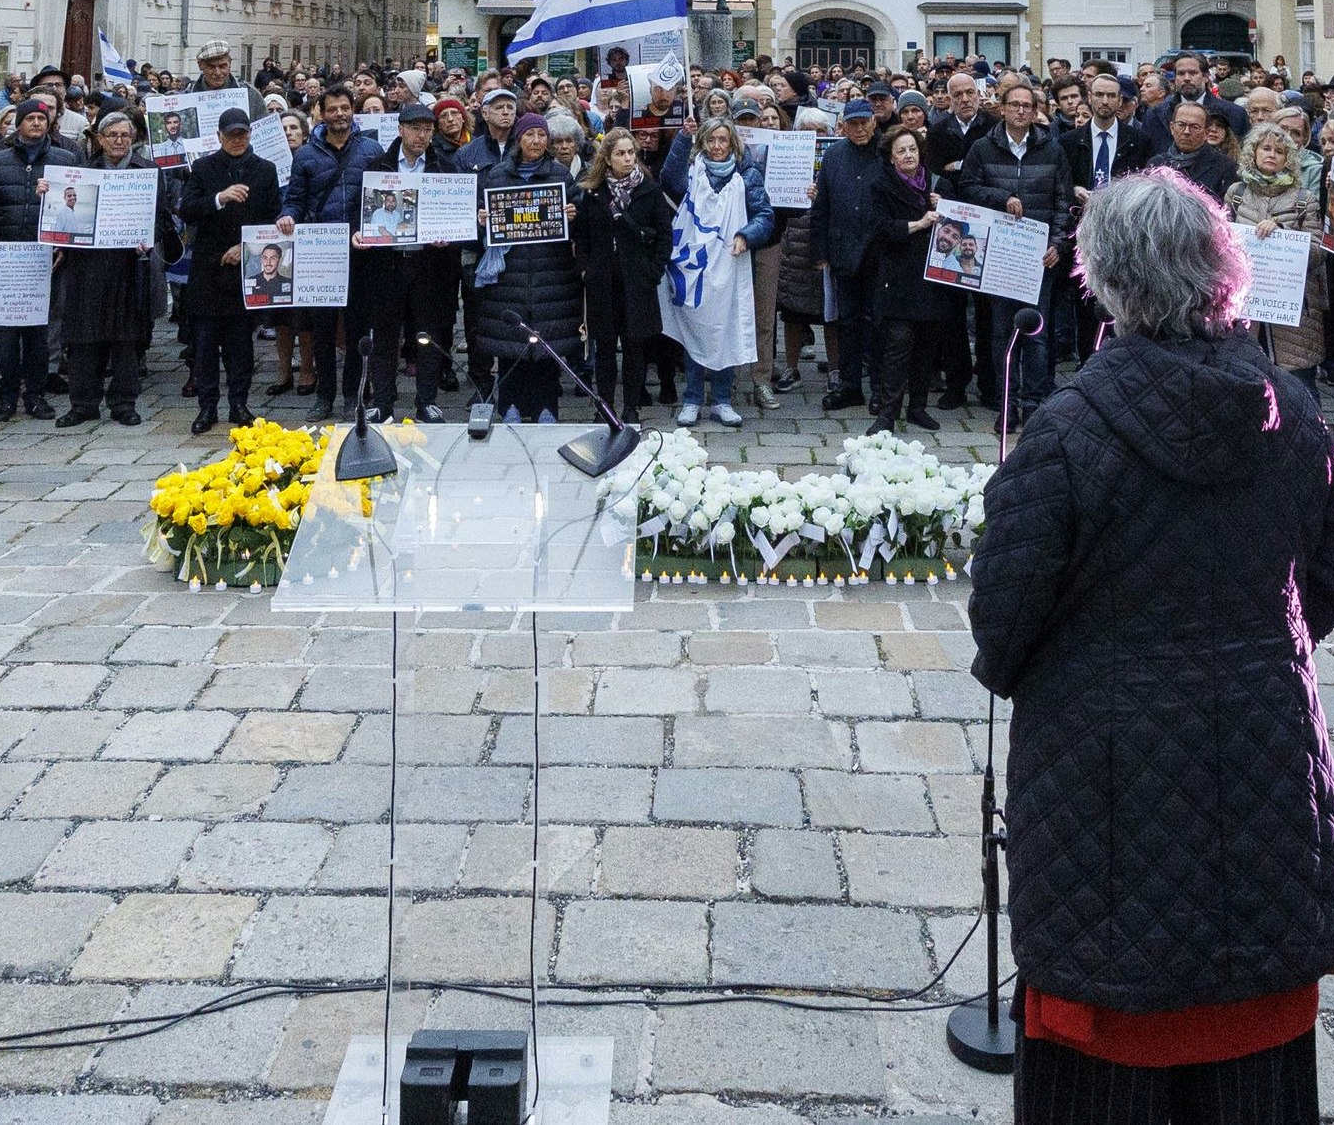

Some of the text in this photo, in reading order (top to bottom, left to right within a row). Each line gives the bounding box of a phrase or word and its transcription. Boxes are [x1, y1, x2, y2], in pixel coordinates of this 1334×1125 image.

[113, 171, 135, 180] THEIR
[136, 170, 157, 179] VOICE
[432, 176, 453, 184] THEIR
[103, 182, 154, 192] Omri Miran
[422, 186, 474, 197] Segev Kalfon
[513, 212, 540, 223] IN HELL
[118, 228, 139, 236] VOICE
[329, 227, 348, 235] VOICE
[1284, 233, 1309, 243] VOICE
[9, 244, 22, 252] HIS
[311, 295, 328, 303] THEY
[1262, 298, 1300, 311] VOICE IS
[1255, 310, 1297, 323] THEY HAVE
